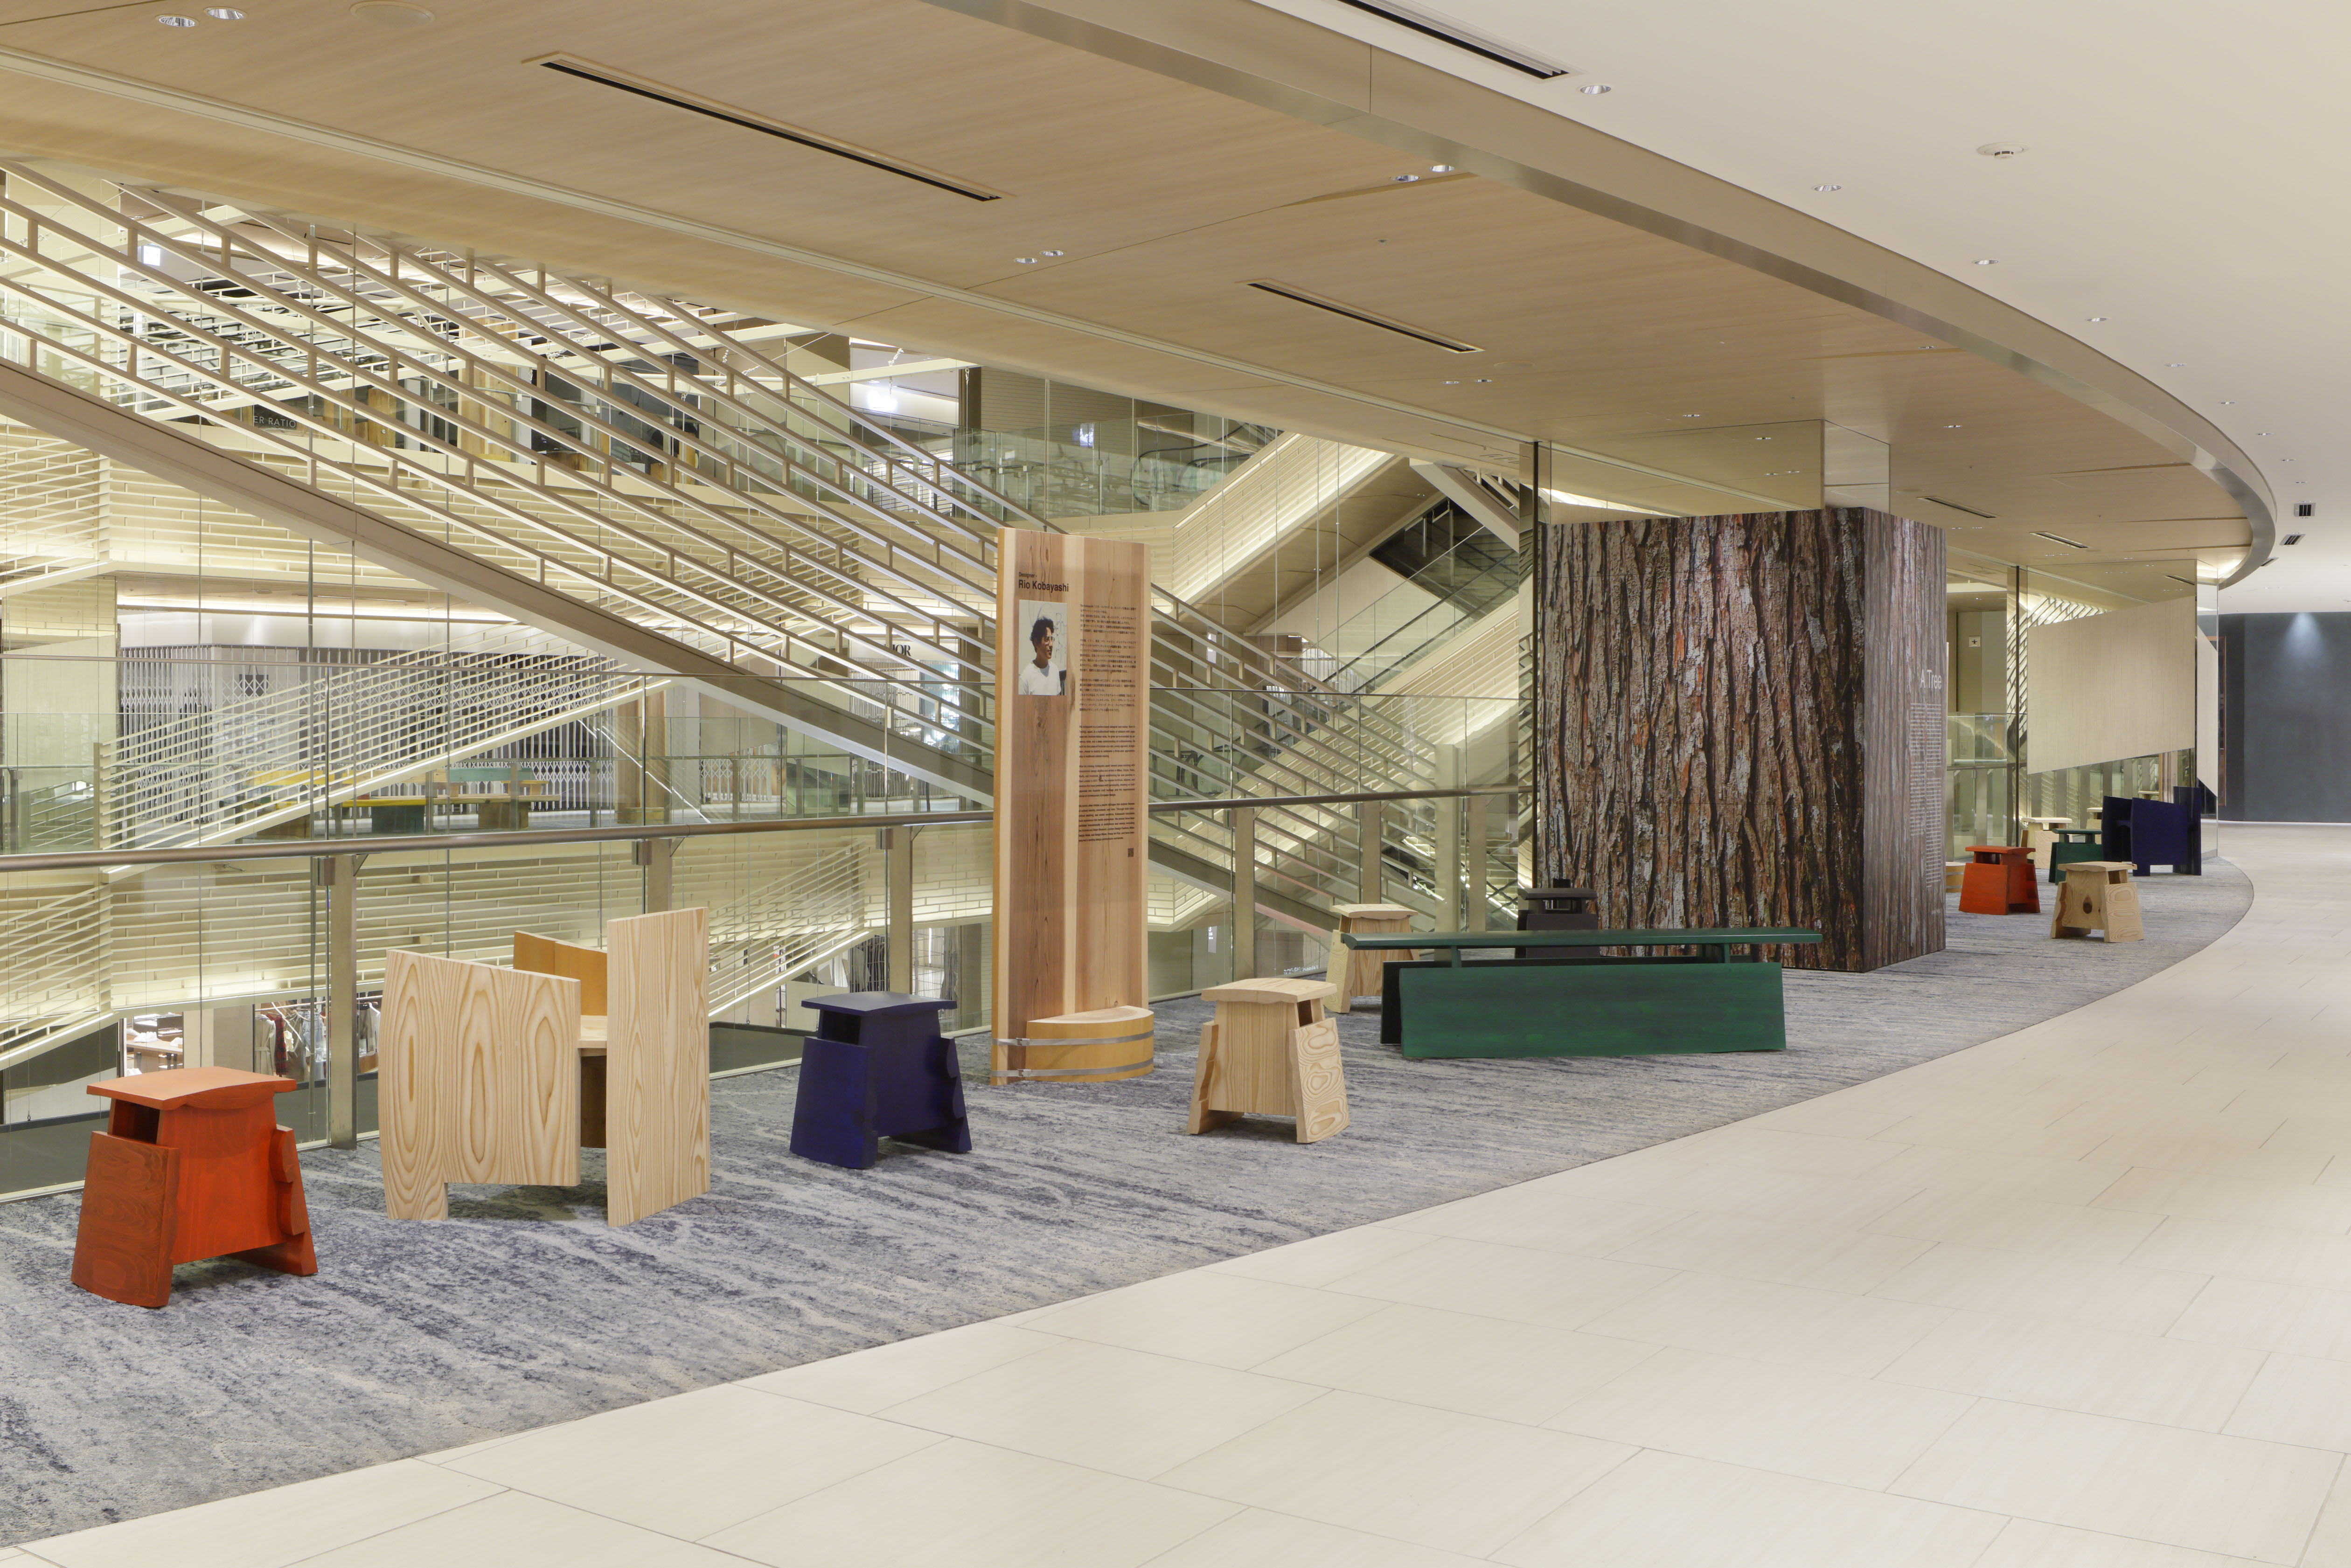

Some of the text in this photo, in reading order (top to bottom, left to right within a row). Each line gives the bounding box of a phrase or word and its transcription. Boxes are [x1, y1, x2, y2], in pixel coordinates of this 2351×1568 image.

[268, 417, 296, 428] RATIO
[1018, 579, 1069, 593] Rio Kobayashi
[885, 644, 911, 657] IOR
[1920, 669, 1942, 689] A Tree
